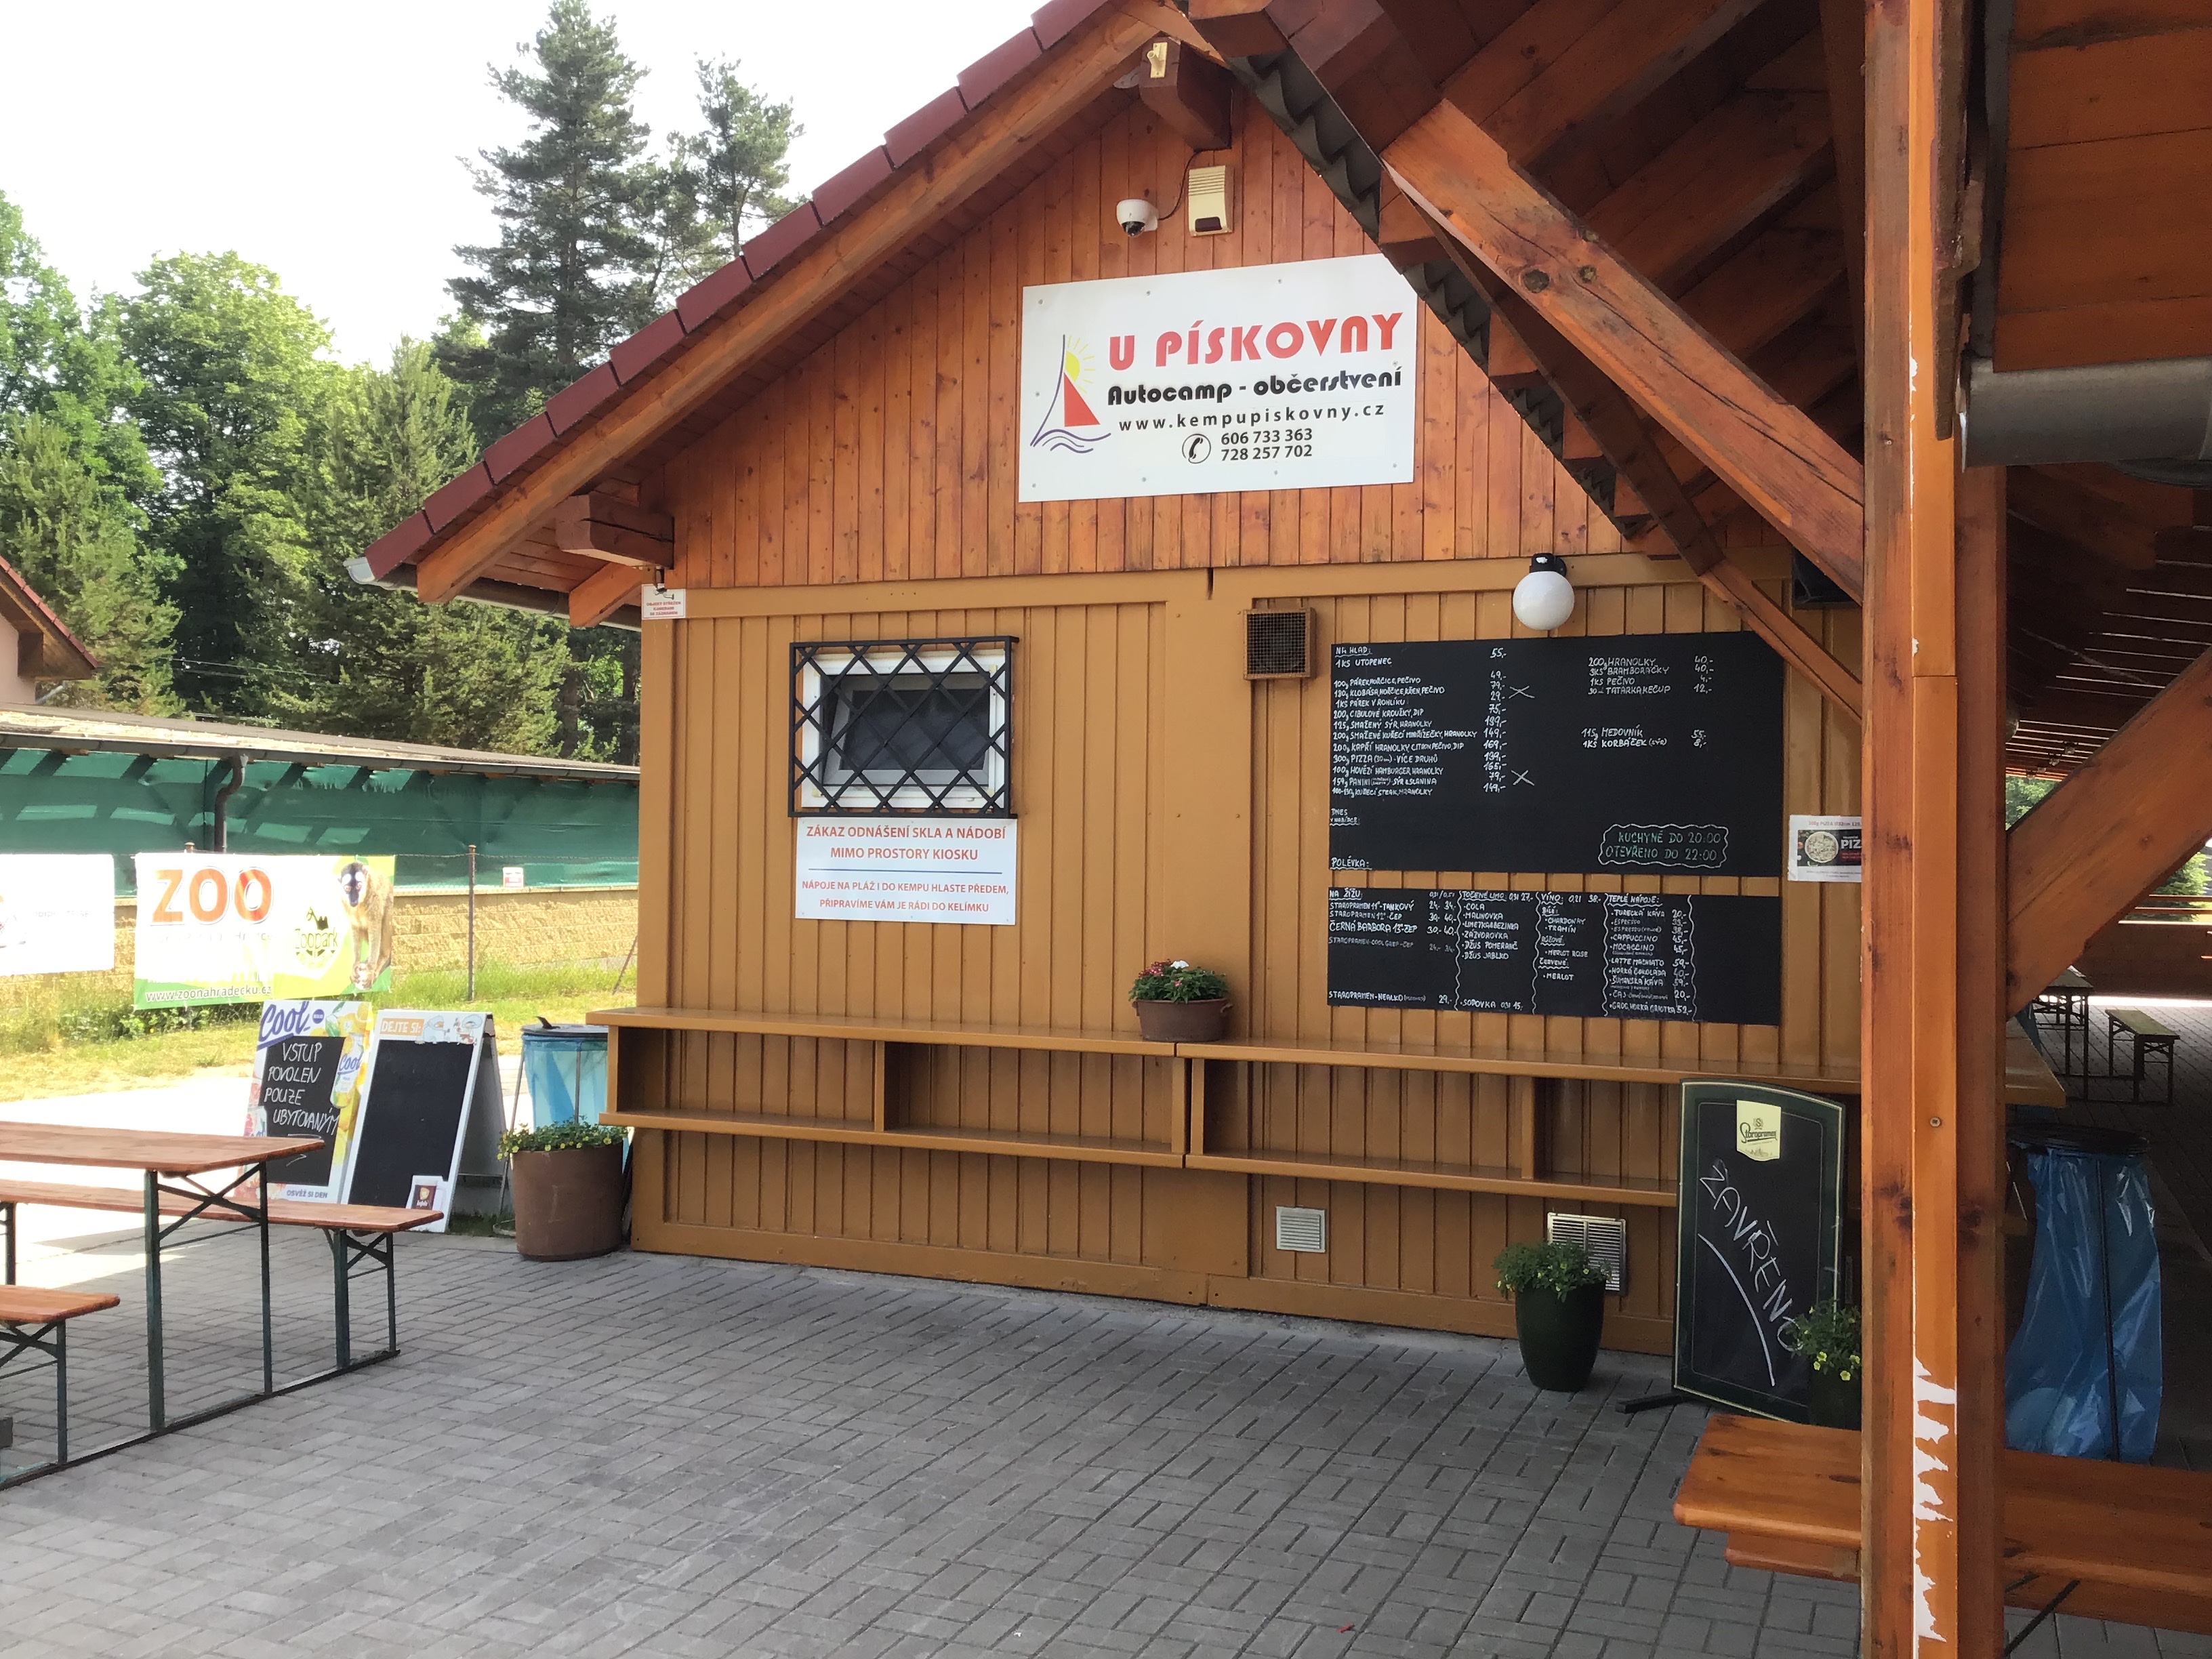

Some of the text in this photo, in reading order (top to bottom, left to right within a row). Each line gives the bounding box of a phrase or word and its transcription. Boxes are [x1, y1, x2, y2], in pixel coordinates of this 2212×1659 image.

[1109, 312, 1404, 371] U PÍSKOVNY
[1107, 381, 1232, 405] Autocamp
[1253, 366, 1402, 396] občerstvení
[1119, 404, 1385, 432] www.kempupiskovny.cz
[1221, 428, 1313, 445] 606 733 363
[1221, 445, 1312, 462] 728 257 702
[1355, 657, 1392, 665] UTOPENEC
[1607, 658, 1656, 666] HRANOLKY
[1491, 671, 1506, 680] 49,-
[1607, 676, 1635, 685] PEČIVO
[1490, 681, 1504, 690] 79,-
[1643, 685, 1671, 693] KEČUP
[1694, 684, 1712, 694] 12,-
[1491, 691, 1505, 701] 29,-
[1350, 697, 1405, 707] PÁREK ROHLÍKU
[1350, 708, 1380, 718] CIBULOVÉ
[1489, 703, 1506, 714] 75,-
[1350, 718, 1382, 729] SMAŽENÝ
[1350, 730, 1381, 739] SMAŽENÉ
[1483, 728, 1506, 738] 149,-
[1601, 724, 1643, 737] MEDOVNÍK
[1483, 740, 1507, 750] 169,-
[1601, 737, 1647, 747] KORBÁČEK
[1351, 754, 1437, 762] PIZZA DRUHŮ
[1483, 762, 1507, 771] 165,-
[1349, 777, 1370, 785] PANINI
[1483, 783, 1506, 793] 149,-
[806, 825, 1006, 840] ZÁKAZ ODNÁŠENÍ SKLA A NÁDOBÍ
[1669, 833, 1683, 843] DO
[1688, 832, 1721, 843] 20:00
[830, 847, 978, 860] MIMO PROSTORY KIOSKU
[1605, 845, 1717, 861] OTEVŘENO DO 22:00
[1331, 855, 1369, 867] POLÉVKA:
[802, 880, 1009, 895] NÁPOJE NA PLÁŽ I DO KEMPU HLASTE PŘEDEM,
[149, 866, 274, 926] ZOO
[1462, 890, 1488, 899] TOČENÉ
[1609, 893, 1659, 903] TEPLÉ NÁPOJE:
[820, 898, 989, 912] PŘIPRAVÍME VÁM JE RÁDI DO KELÍMKU
[1614, 908, 1687, 919] TURECKÁ KÁVA 20,-
[1330, 920, 1391, 933] ČERNÁ BARBORA
[1548, 924, 1576, 933] TRAMÍN
[294, 927, 338, 950] Zoopark
[1465, 939, 1518, 949] DŽUS POMERANČ
[1613, 934, 1687, 944] CAPPUCCINO 45,-
[1465, 951, 1481, 960] DŽUS
[1674, 945, 1688, 955] 45,-
[1673, 958, 1689, 969] 59,-
[1612, 966, 1666, 977] HORKÁ ČOKOLÁDA
[1644, 976, 1664, 986] KÁVA
[146, 985, 272, 1003] www.zoonahradecku.cz
[1613, 990, 1626, 998] ČAJ
[1674, 990, 1691, 1001] 20,-
[259, 1001, 310, 1042] Cool
[382, 1021, 408, 1032] DEJTE
[283, 1042, 323, 1062] VSTUP
[268, 1066, 321, 1083] POVOLEN
[264, 1086, 305, 1106] POUZE
[272, 1107, 339, 1135] UBYTOVANÝM
[287, 1189, 306, 1197] OSVĚŽ
